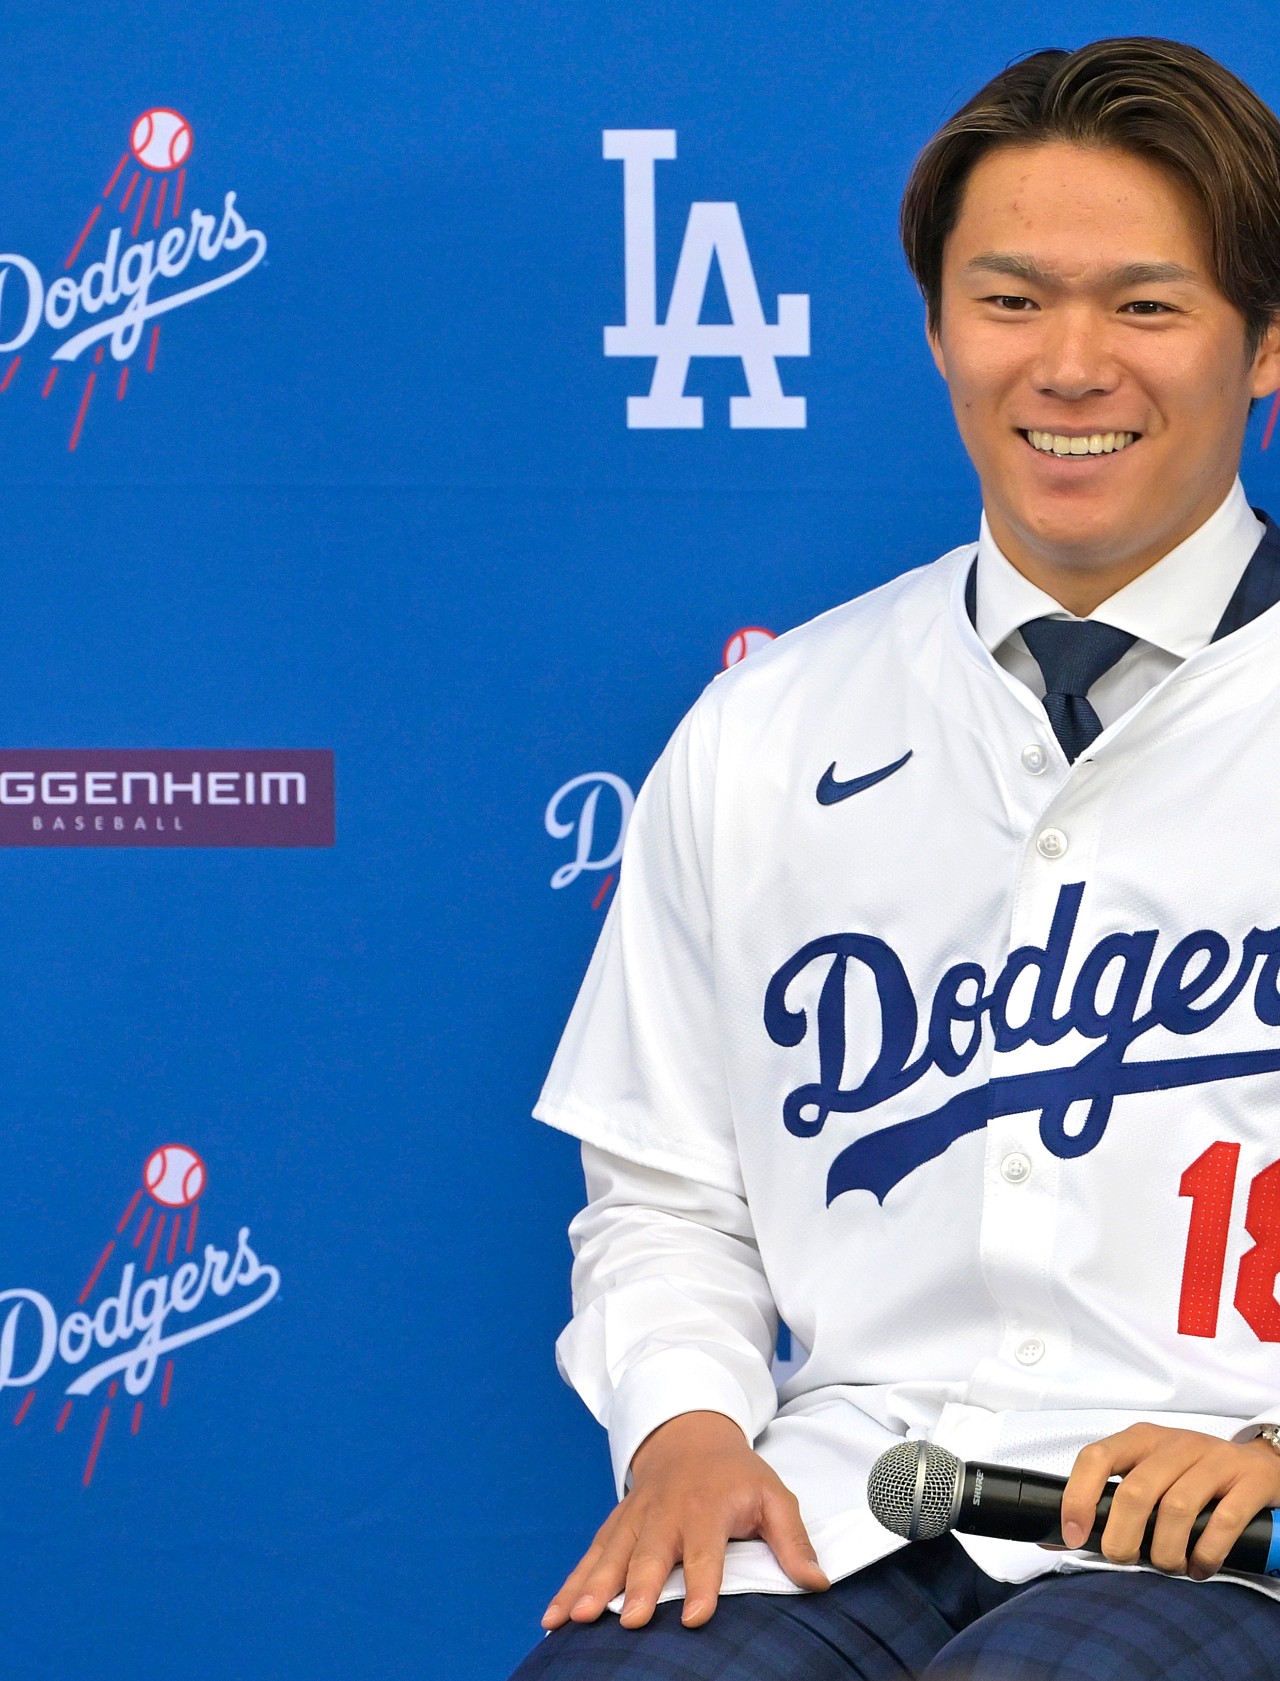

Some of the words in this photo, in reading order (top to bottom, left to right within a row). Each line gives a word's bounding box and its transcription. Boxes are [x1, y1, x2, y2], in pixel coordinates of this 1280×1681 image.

[602, 129, 811, 429] LA
[32, 815, 184, 831] BASEBALL
[972, 1471, 985, 1507] SHURE
